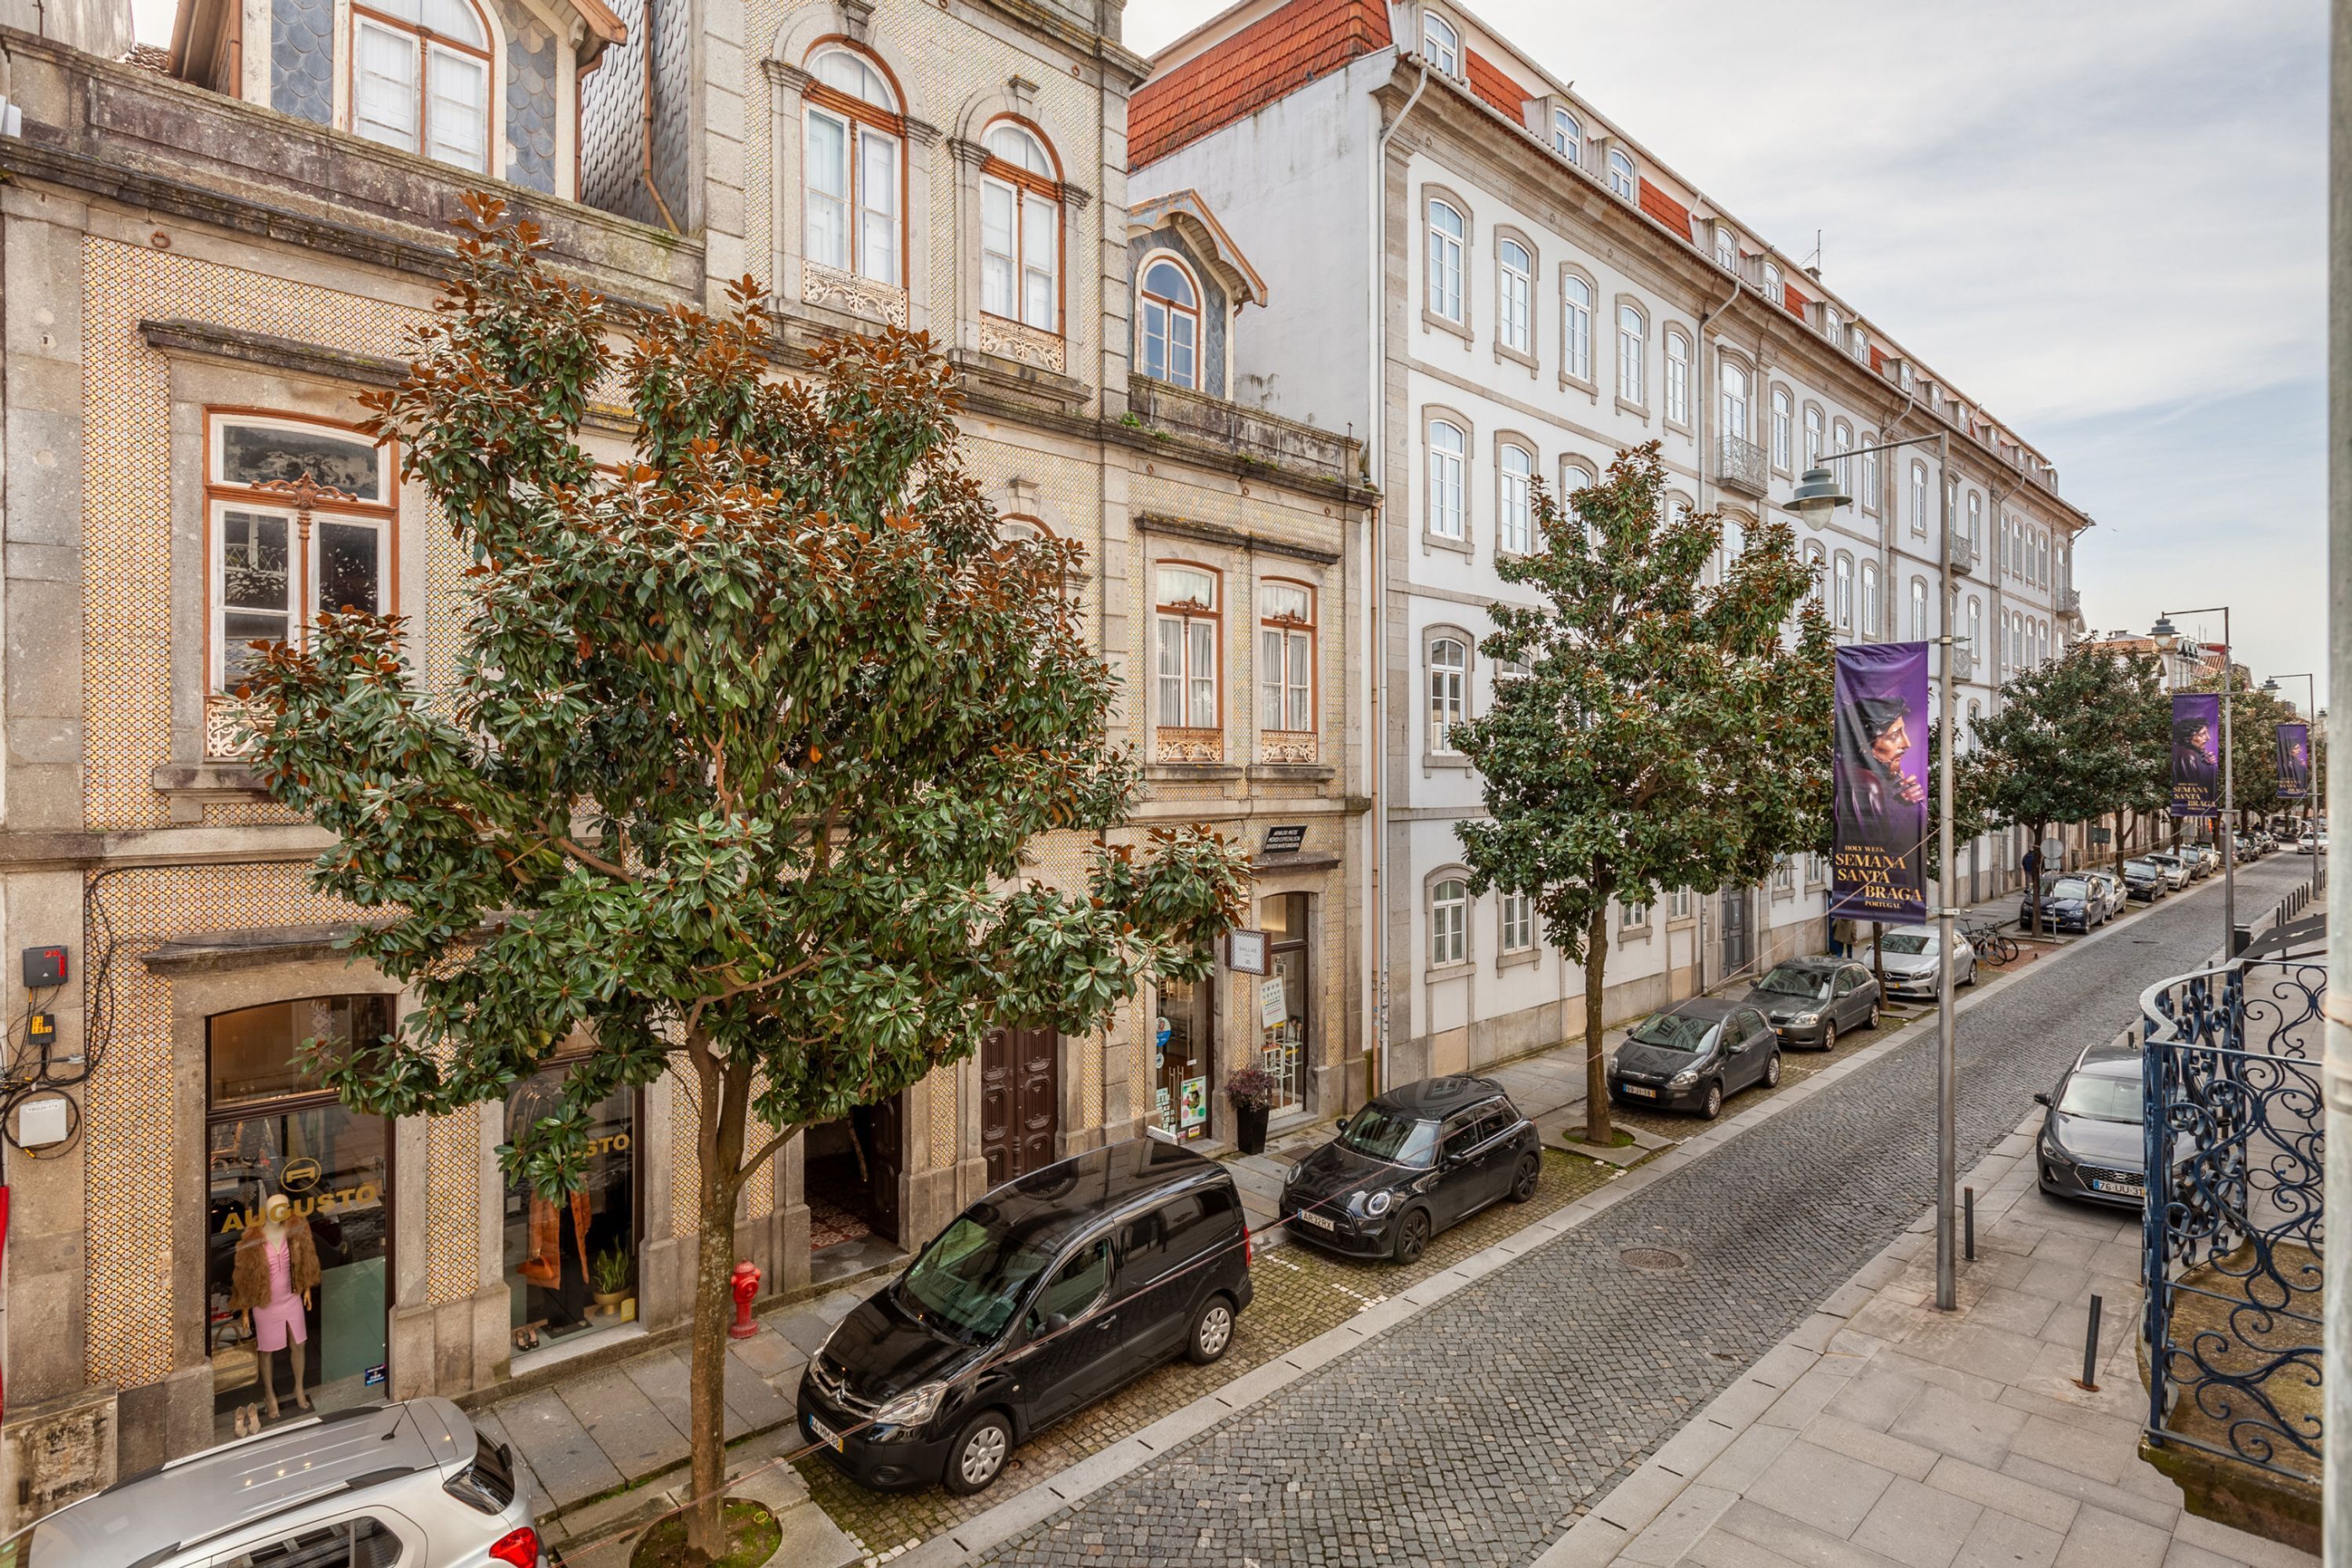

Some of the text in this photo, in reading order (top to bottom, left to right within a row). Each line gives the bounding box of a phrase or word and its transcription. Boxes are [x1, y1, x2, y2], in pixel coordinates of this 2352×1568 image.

[1835, 852, 1907, 869] SEMANA
[1837, 868, 1890, 884] SANTA
[1866, 884, 1923, 902] BRAGA
[1864, 900, 1902, 909] PORTUGAL
[220, 1185, 377, 1234] AUGUSTO
